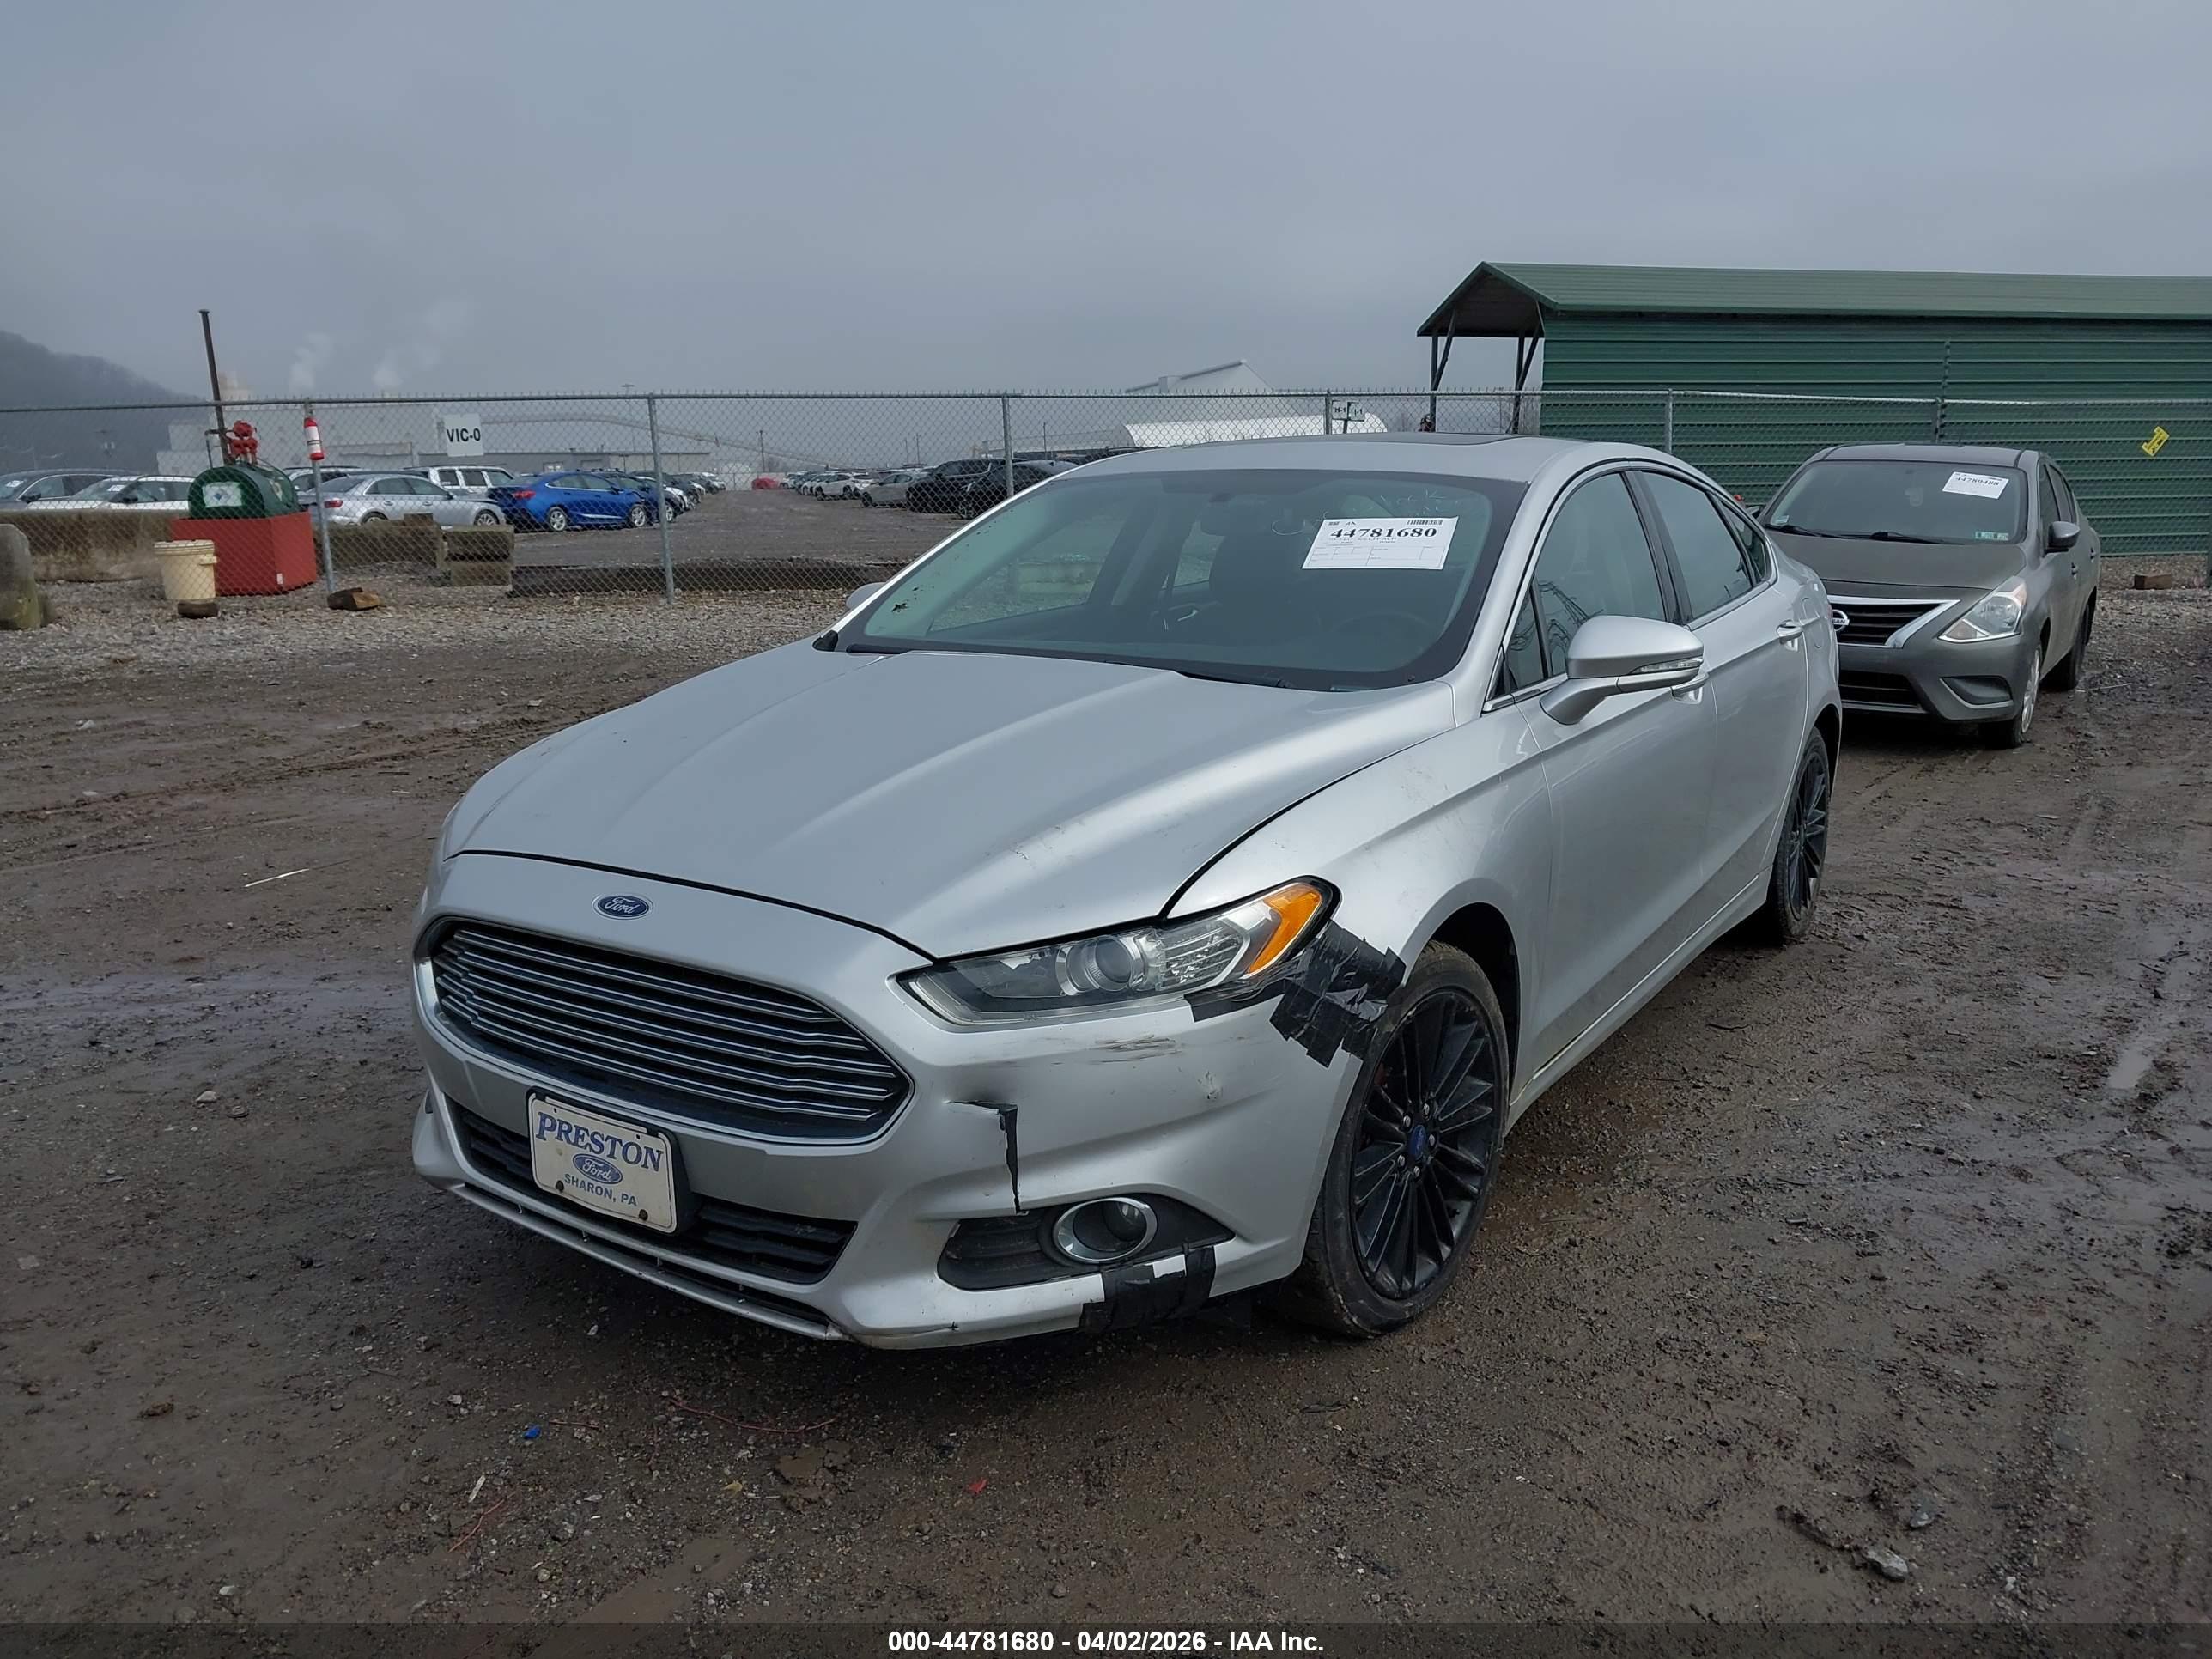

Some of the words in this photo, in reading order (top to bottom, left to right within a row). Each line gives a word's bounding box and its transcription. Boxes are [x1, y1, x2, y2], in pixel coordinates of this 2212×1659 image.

[1330, 527, 1437, 538] 44781680
[604, 896, 641, 915] Ford
[535, 1111, 664, 1172] PRESTON
[581, 1159, 611, 1181] Ford
[564, 1173, 617, 1203] SHARON,
[621, 1193, 638, 1206] PA
